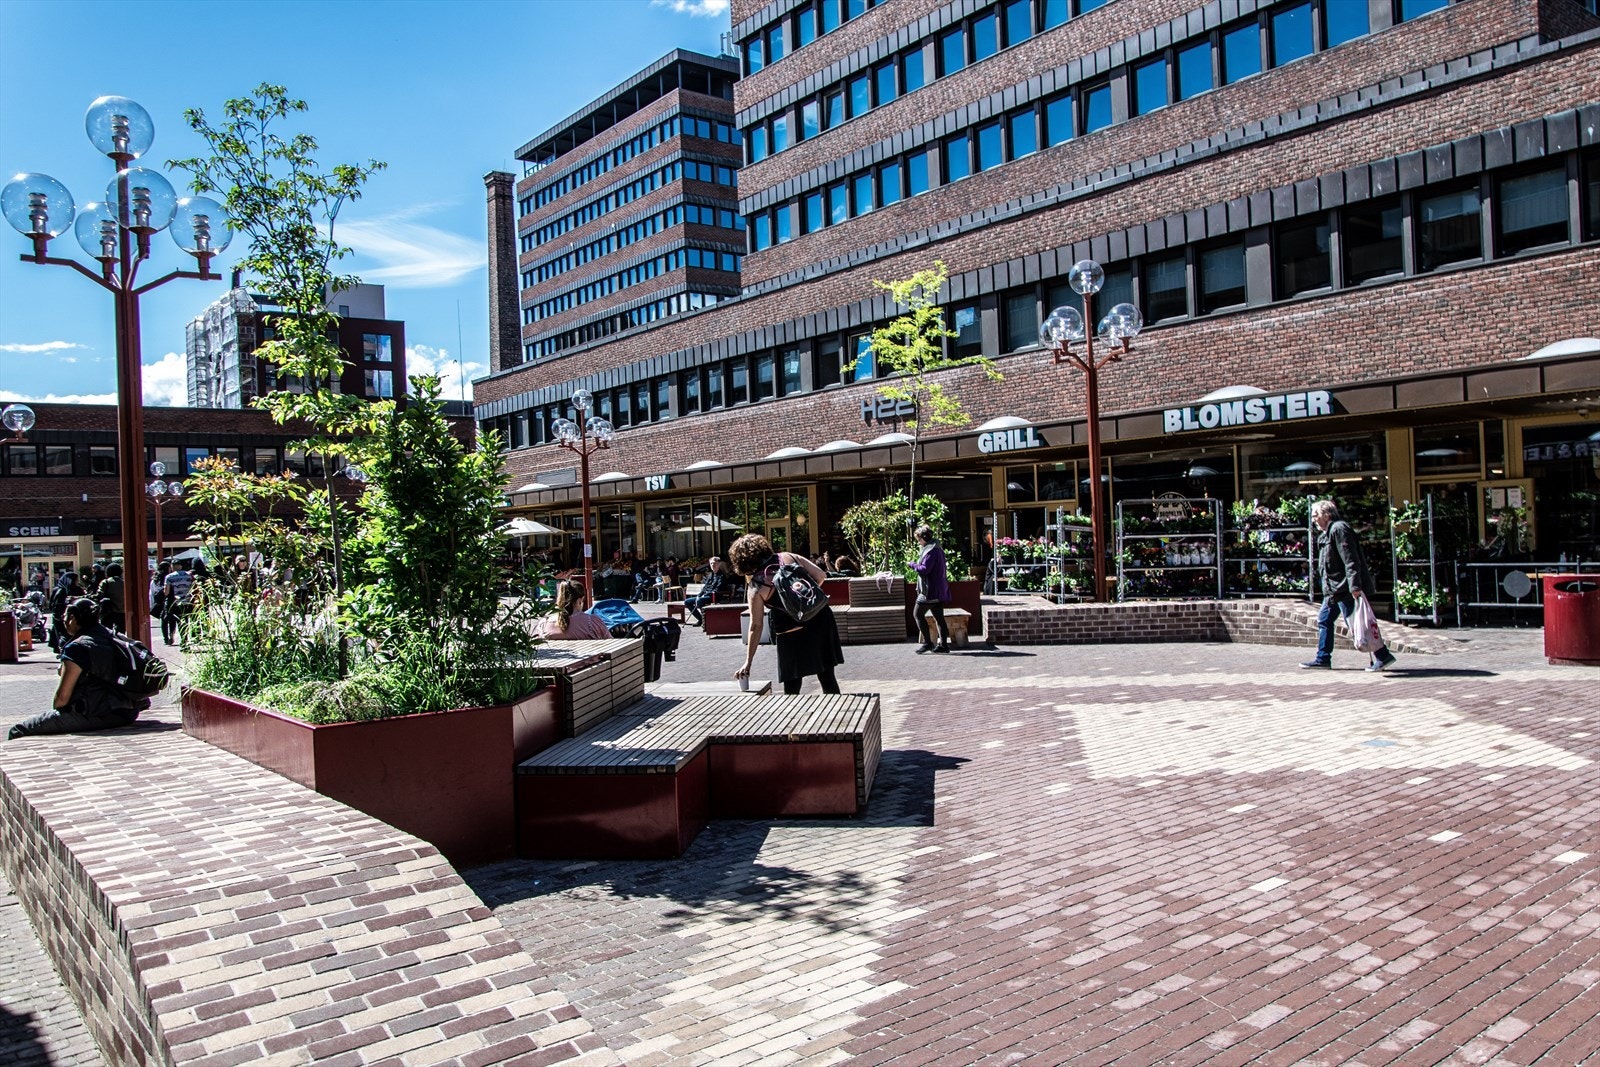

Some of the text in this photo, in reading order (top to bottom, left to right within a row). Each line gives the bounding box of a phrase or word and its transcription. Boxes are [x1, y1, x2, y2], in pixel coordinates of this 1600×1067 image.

[1164, 390, 1331, 433] BLOMSTER
[978, 427, 1040, 454] GRILL
[644, 474, 667, 491] TSV
[9, 526, 60, 537] SCENE
